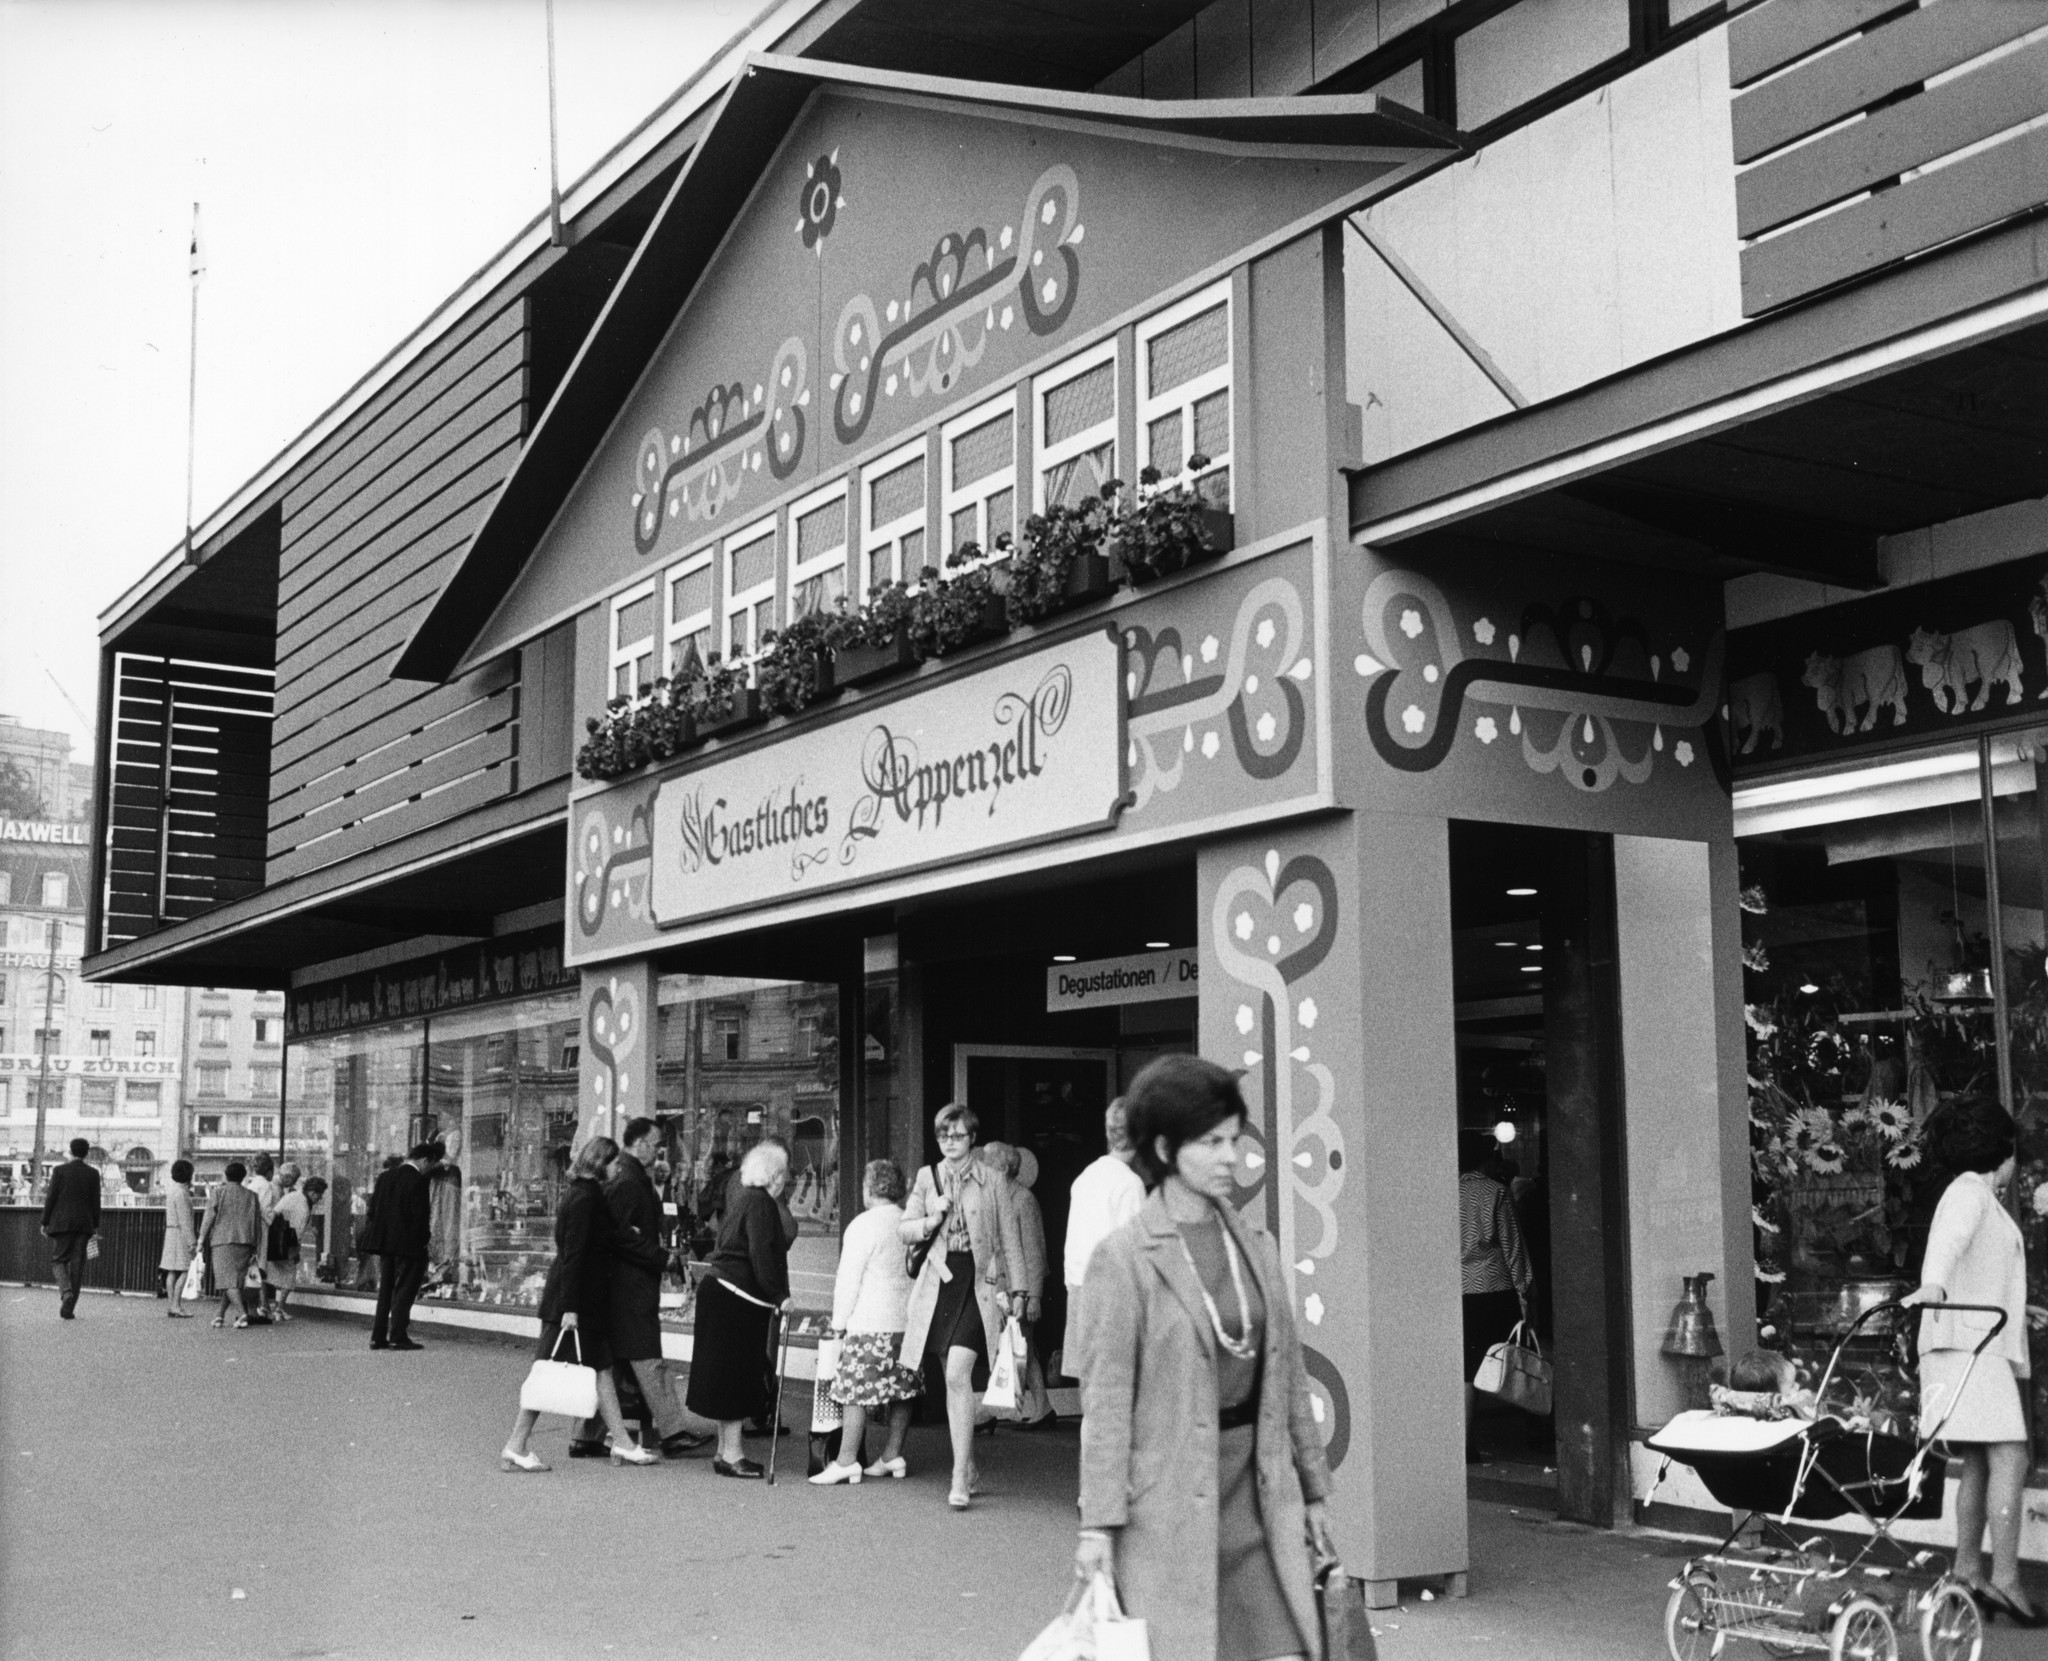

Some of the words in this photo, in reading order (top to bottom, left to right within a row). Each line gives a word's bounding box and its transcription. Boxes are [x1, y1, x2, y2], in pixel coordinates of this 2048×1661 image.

[680, 776, 829, 882] Gastliches
[838, 663, 1073, 866] Appenzell
[0, 817, 84, 845] AXWELL
[1059, 968, 1156, 998] Degustationen
[83, 1057, 175, 1074] ZÜRICH
